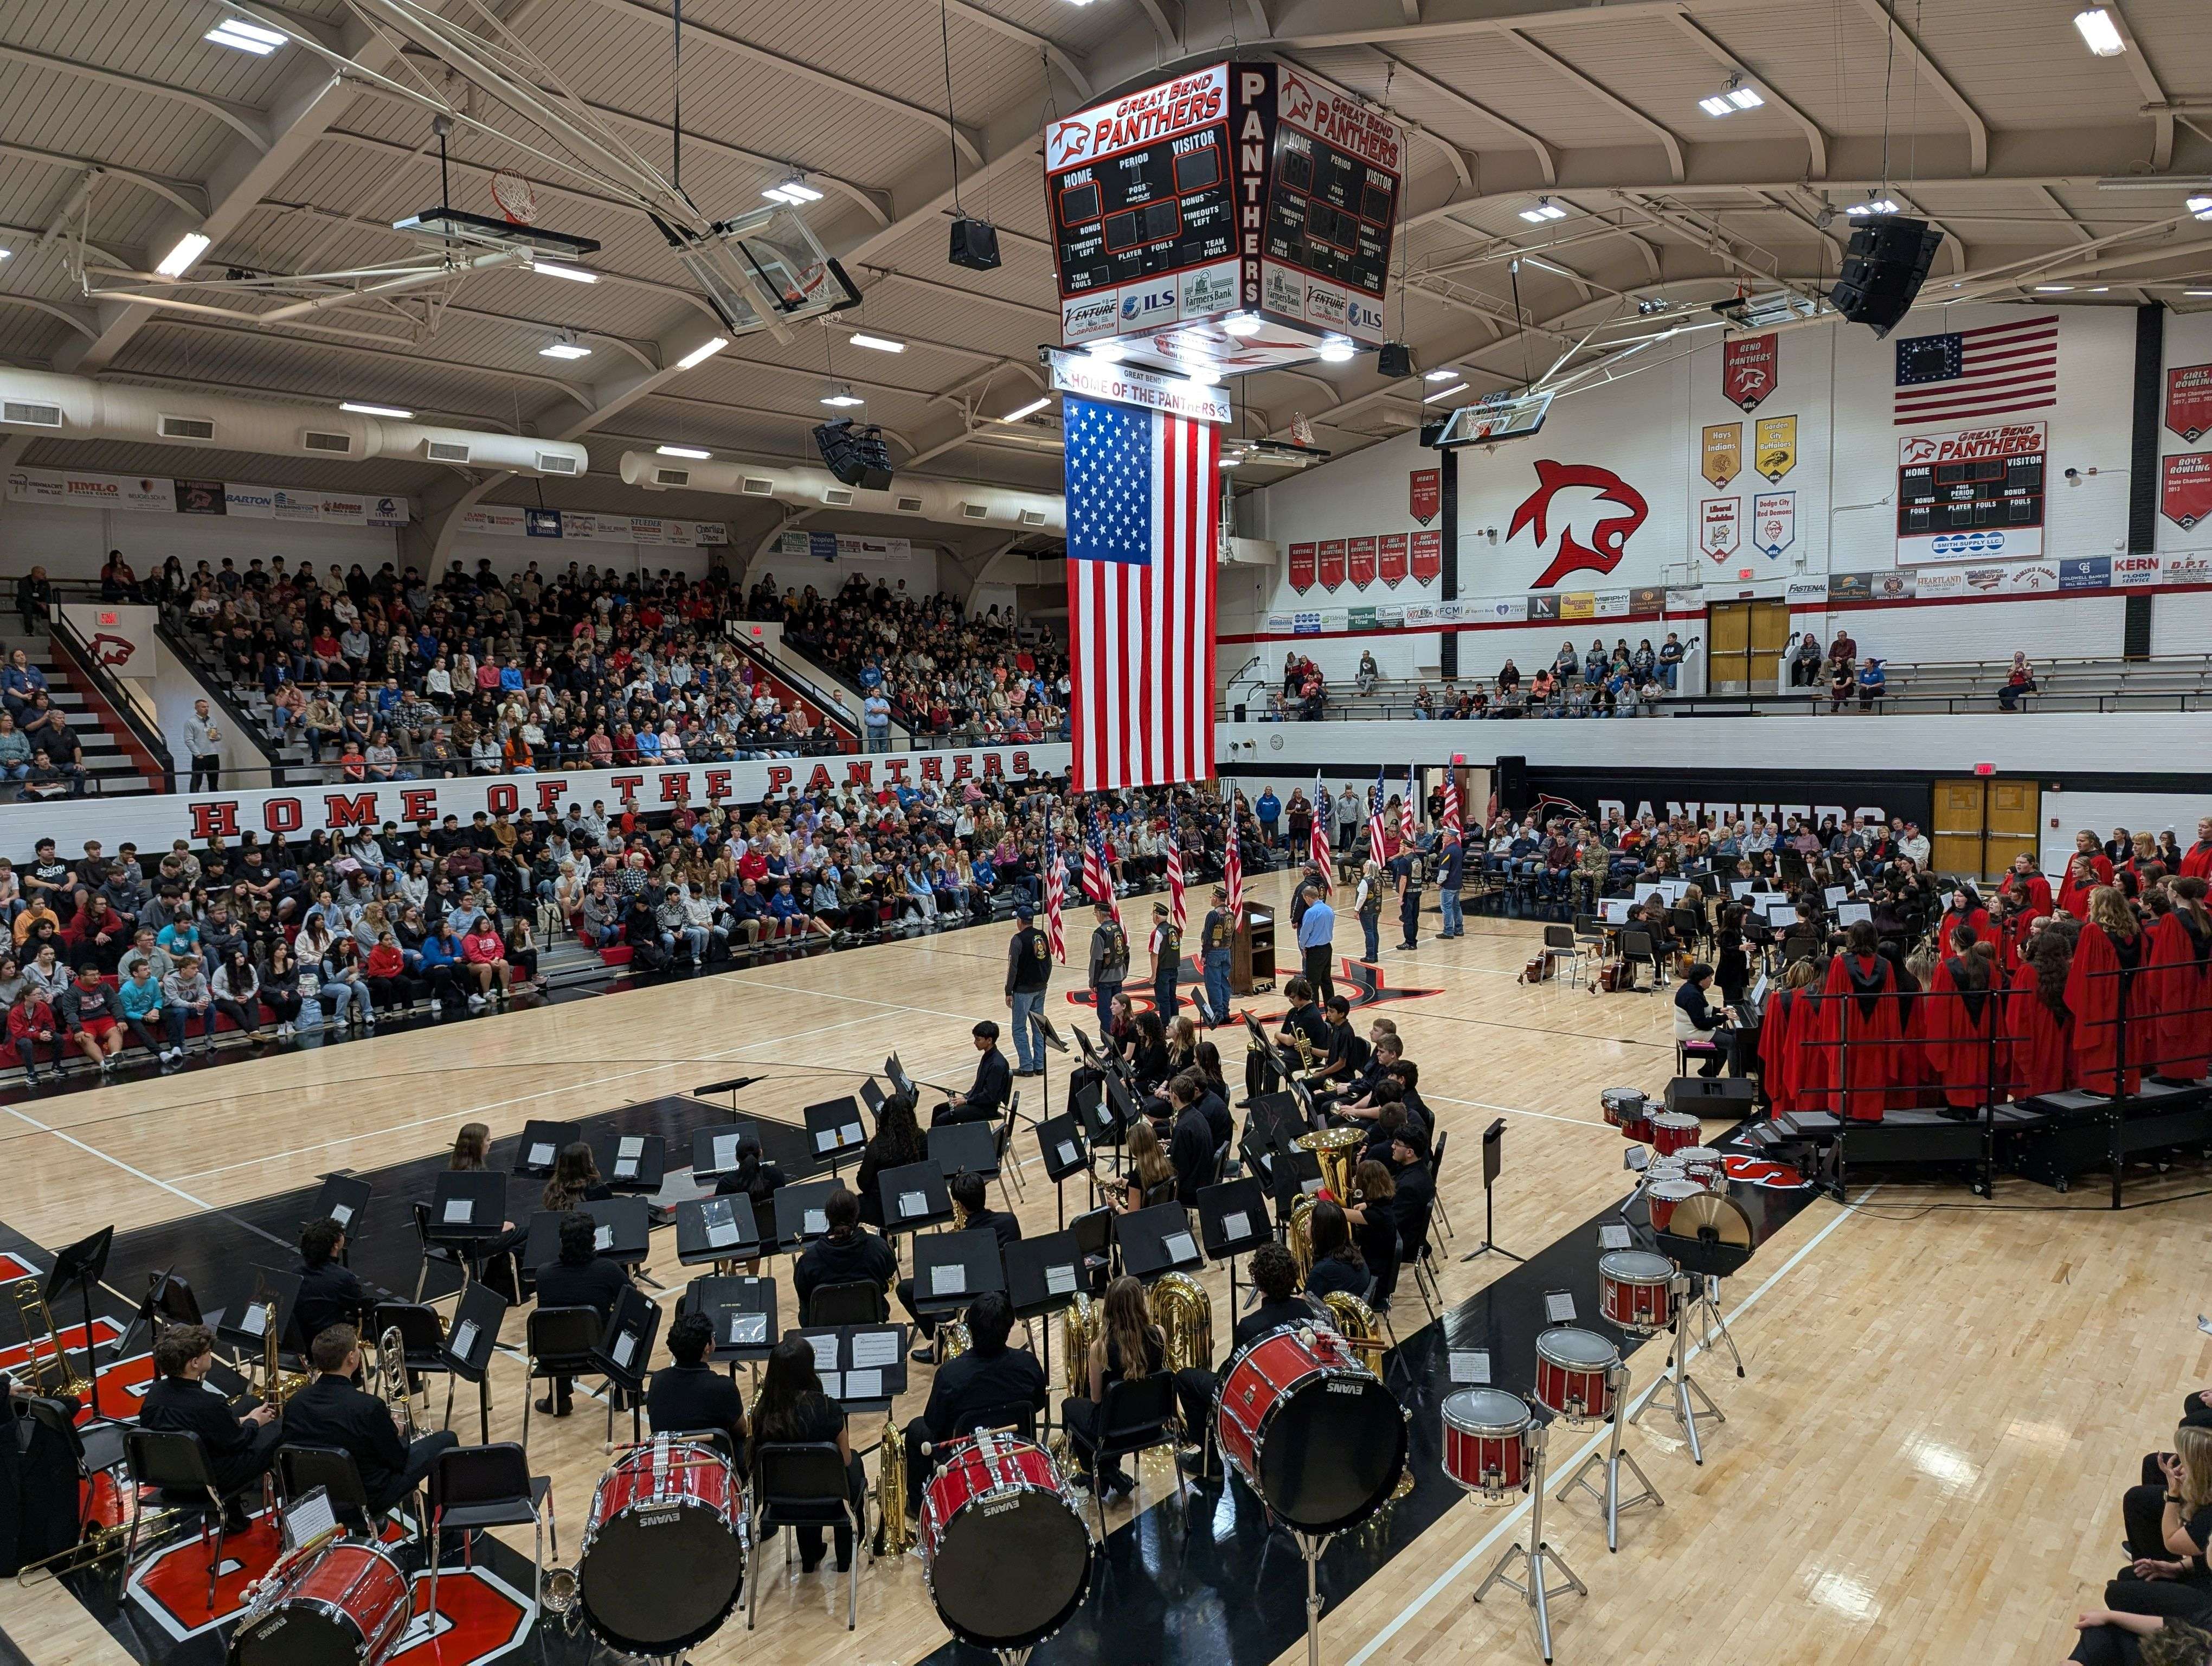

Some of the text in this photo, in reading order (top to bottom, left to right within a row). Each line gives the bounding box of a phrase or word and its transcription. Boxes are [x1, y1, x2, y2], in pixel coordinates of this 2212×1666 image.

[1117, 73, 1214, 118] GREAT BEND
[1092, 87, 1224, 156] PANTHERS
[1332, 97, 1394, 139] GREAT BEND
[1313, 100, 1399, 169] PANTHERS
[1172, 130, 1216, 156] VISITOR
[1289, 131, 1312, 155] HOME
[1119, 153, 1149, 170] PERIOD
[1331, 154, 1351, 170] PERIOD
[1064, 168, 1093, 188] HOME
[1366, 168, 1392, 191] VISITOR
[1129, 184, 1147, 195] POSS
[1241, 72, 1266, 302] PANTHERS
[1331, 185, 1343, 196] POSS
[1181, 194, 1205, 207] BONUS
[1289, 195, 1306, 208] BONUS
[1183, 206, 1219, 221] TIMEOUTS
[1279, 206, 1304, 222] TIMEOUTS
[1193, 216, 1210, 227] LEFT
[1284, 217, 1296, 228] LEFT
[1080, 223, 1101, 235] BONUS
[1360, 224, 1375, 236] BONUS
[1071, 238, 1102, 252] TIMEOUTS
[1151, 240, 1173, 252] FOULS
[1205, 238, 1225, 248] TEAM
[1274, 238, 1287, 249] TEAM
[1311, 241, 1328, 254] PLAYER
[1359, 238, 1380, 252] TIMEOUTS
[1079, 247, 1095, 257] LEFT
[1118, 249, 1142, 261] PLAYER
[1204, 246, 1227, 257] FOULS
[1271, 246, 1287, 257] FOULS
[1334, 250, 1348, 261] FOULS
[1364, 248, 1374, 258] LEFT
[1072, 272, 1089, 281] TEAM
[1366, 272, 1378, 283] TEAM
[1071, 279, 1091, 289] FOULS
[1364, 279, 1378, 290] FOULS
[1144, 290, 1175, 311] ILS
[1185, 287, 1232, 307] Farmers Bank
[1267, 289, 1300, 307] Farmers Bank
[1196, 304, 1214, 315] Trust
[1275, 302, 1288, 313] Trust
[1064, 303, 1117, 326] VENTURE
[1362, 309, 1382, 328] ILS
[1740, 342, 1761, 353] BEND
[1729, 353, 1771, 367] PANTHERS
[1124, 369, 1144, 380] GREAT
[1145, 374, 1162, 384] BEND
[2183, 370, 2208, 380] GIRLS
[1112, 382, 1216, 418] OF THE PANTHERS
[1764, 421, 1788, 430] Garden
[1713, 431, 1731, 440] Hays
[1770, 432, 1782, 440] City
[1958, 425, 2035, 442] GREAT BEND
[1708, 443, 1736, 452] Indians
[1760, 441, 1791, 451] Buffaloes
[1937, 433, 2042, 460] PANTHERS
[2007, 456, 2042, 467] VISITOR
[2178, 457, 2203, 466] BOYS
[1905, 467, 1930, 477] HOME
[2170, 463, 2210, 475] BOWLING
[67, 480, 118, 493] JIMLO
[226, 494, 271, 505] BARTON
[1759, 498, 1790, 508] Dodge City
[1709, 503, 1732, 513] Liberal
[1948, 501, 1997, 511] PLAYER FOULS
[631, 518, 662, 527] STUEDER
[536, 527, 557, 535] Bank
[809, 535, 835, 543] Peoples
[2114, 558, 2159, 572] KERN
[2171, 560, 2209, 569] D.P.T.
[2037, 567, 2057, 580] FARMS
[1917, 575, 1962, 585] HEARTLAND
[1789, 584, 1826, 592] FASTENAL
[1406, 611, 1419, 619] 007
[1439, 606, 1463, 615] FCMI
[188, 751, 1031, 840] HOME OF THE PANTHERS
[1327, 1382, 1364, 1395] EVANS
[983, 1500, 1020, 1517] EVANS
[640, 1512, 680, 1527] EVANS
[258, 1617, 287, 1641] EVANS
